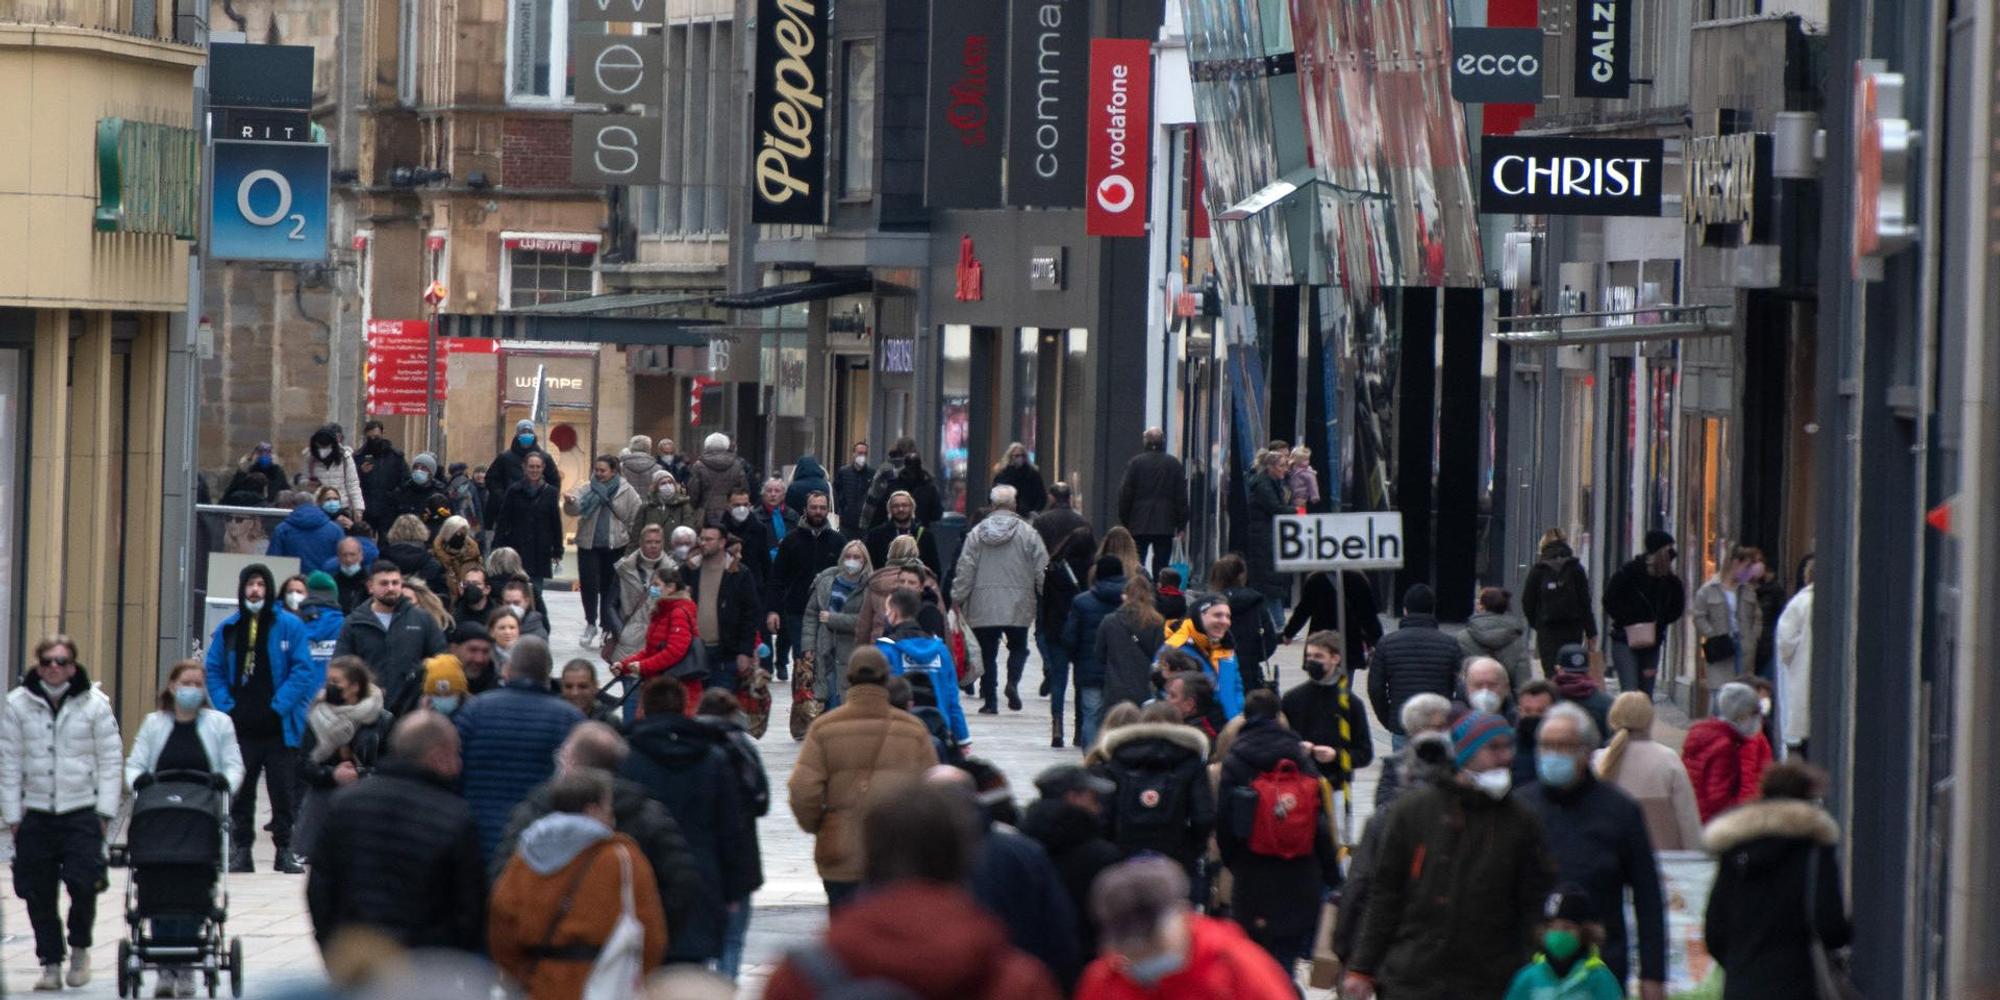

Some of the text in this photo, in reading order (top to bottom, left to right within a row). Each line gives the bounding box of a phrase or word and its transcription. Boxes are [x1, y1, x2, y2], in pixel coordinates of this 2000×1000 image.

[1591, 0, 1616, 83] CALZ
[1456, 53, 1539, 76] ecco
[1109, 63, 1129, 170] vodafone
[1492, 155, 1651, 197] CHRIST
[1278, 516, 1400, 561] Bibeln
